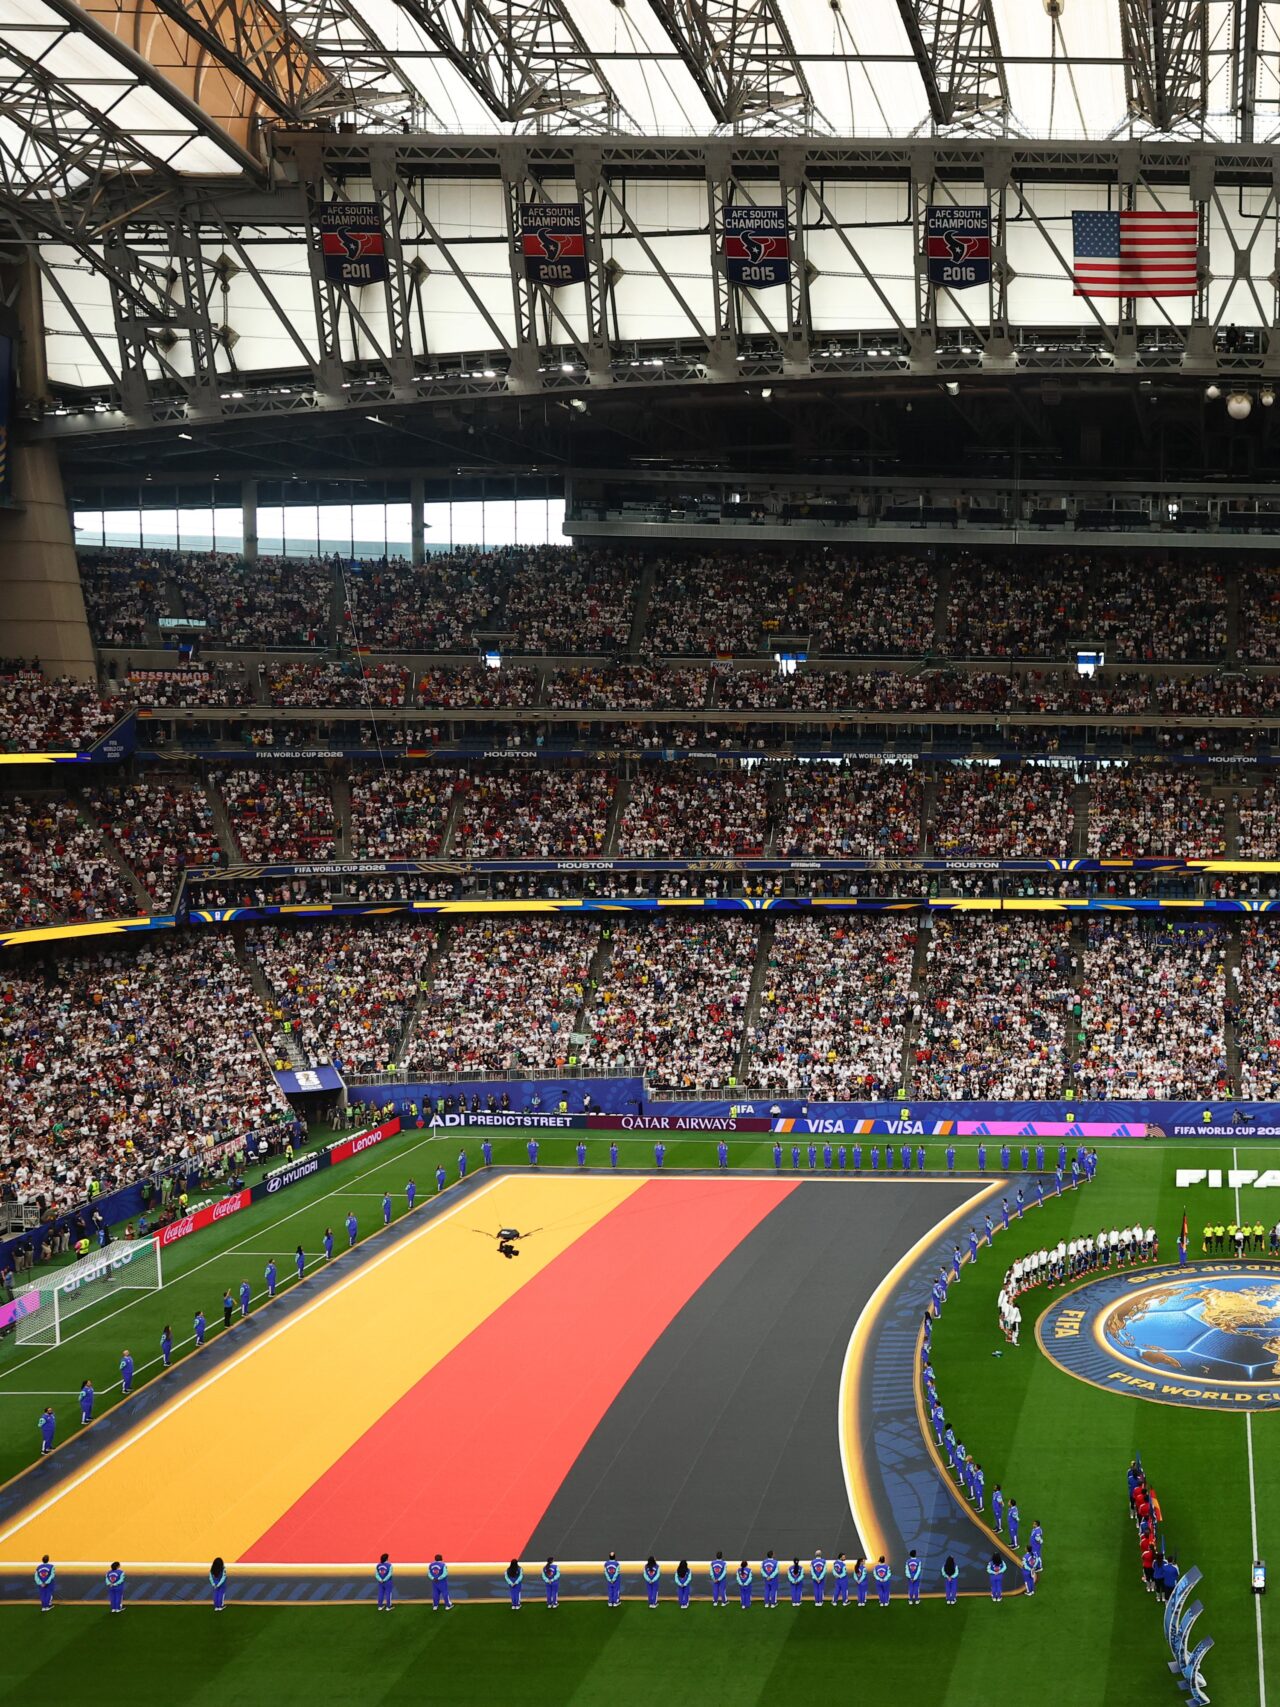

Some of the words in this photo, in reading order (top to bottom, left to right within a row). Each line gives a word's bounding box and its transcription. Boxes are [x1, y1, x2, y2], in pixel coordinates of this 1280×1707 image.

[328, 206, 344, 214] AFC
[345, 206, 373, 214] SOUTH
[322, 215, 380, 226] CHAMPIONS
[522, 216, 580, 226] CHAMPIONS
[725, 218, 784, 229] CHAMPIONS
[928, 218, 987, 229] CHAMPIONS
[342, 264, 370, 278] 2011
[539, 264, 572, 279] 2012
[742, 267, 774, 281] 2015
[943, 267, 975, 281] 2016
[734, 1104, 755, 1114] IFA
[429, 1114, 465, 1128] ADI
[469, 1115, 572, 1127] PREDICTSTREET
[622, 1117, 669, 1130] QATAR
[676, 1118, 737, 1130] AIRWAYS
[804, 1119, 845, 1133] VISA
[884, 1120, 924, 1135] VISA
[1174, 1126, 1196, 1135] FIFA
[1197, 1126, 1233, 1135] WORLD
[1235, 1126, 1256, 1135] CUP
[352, 1131, 382, 1152] Lenovo
[282, 1160, 318, 1184] HYUNDAI
[212, 1194, 241, 1221] Coca-Cola
[164, 1215, 194, 1244] Coca-Cola
[1128, 1268, 1198, 1284] 2026
[1055, 1309, 1086, 1339] FIFA
[1107, 1372, 1156, 1391] FIFA
[1161, 1385, 1253, 1401] WORLD
